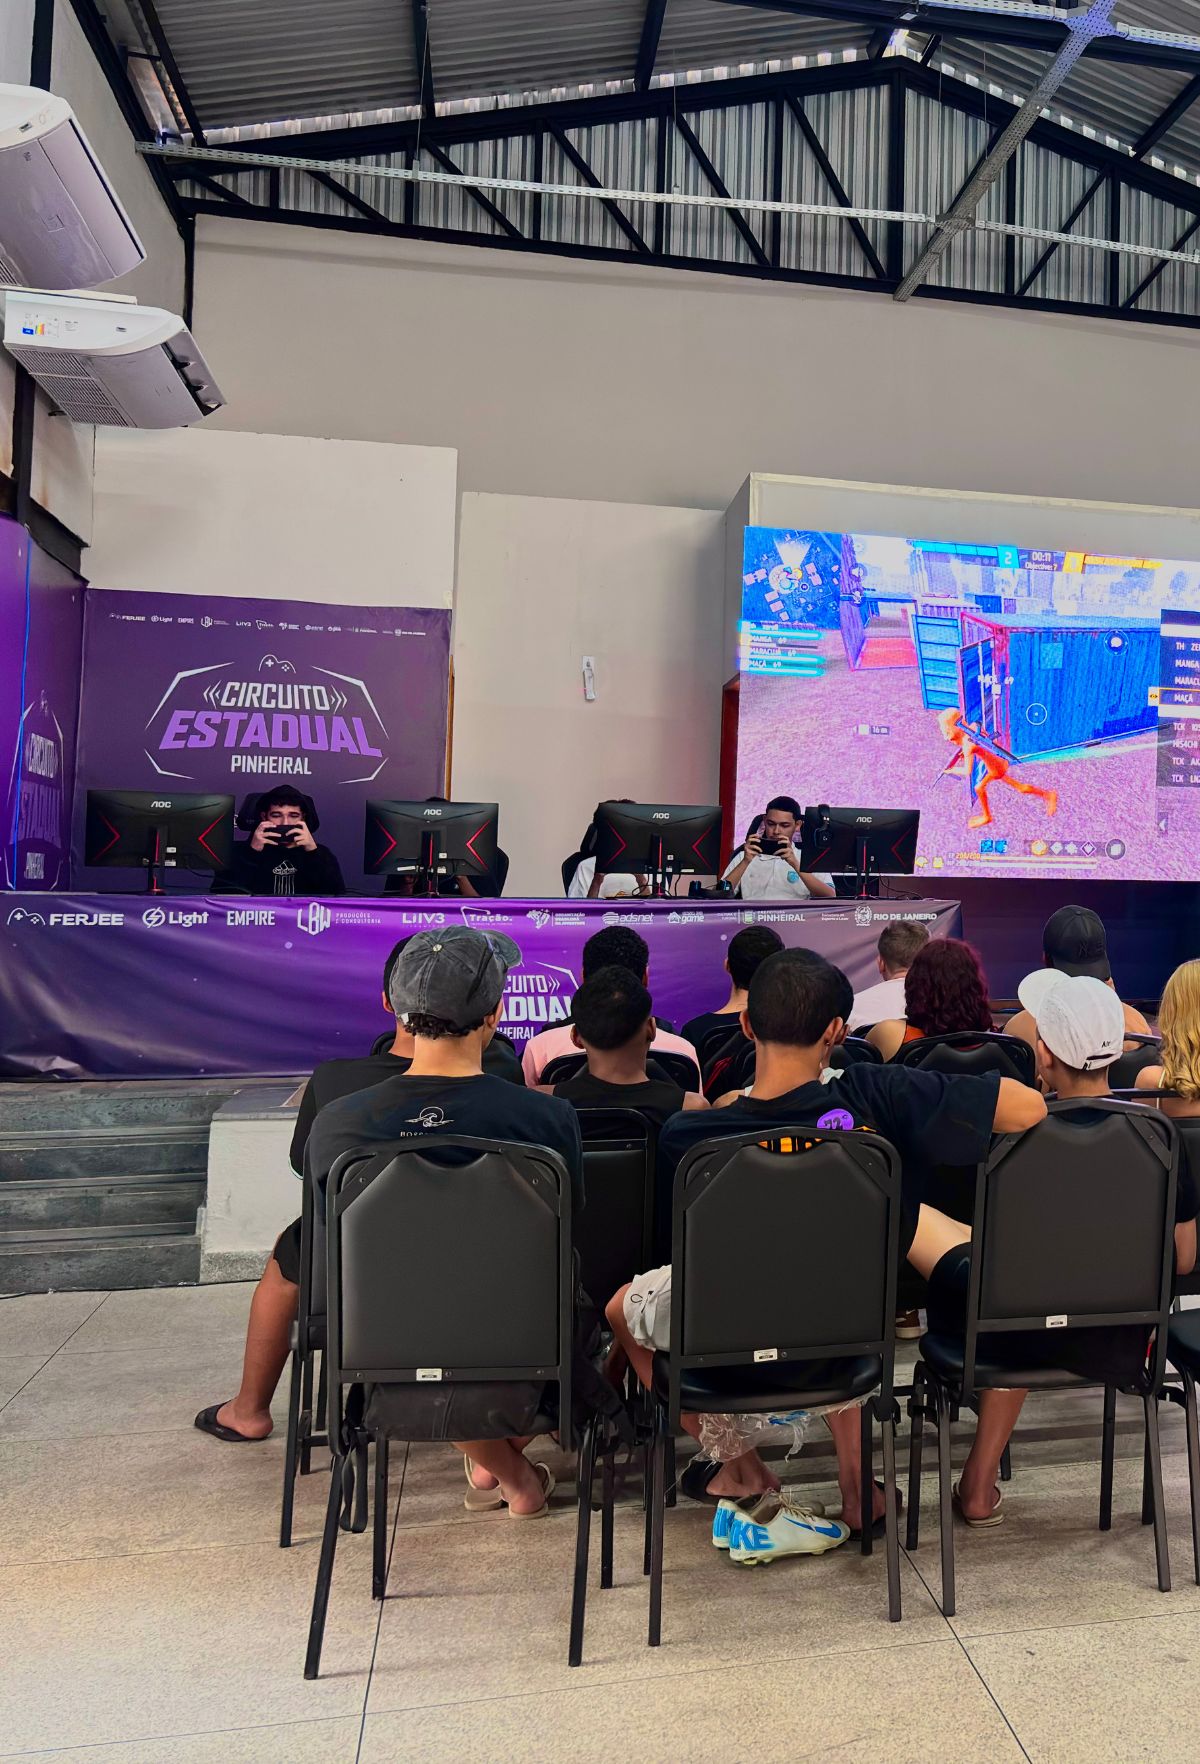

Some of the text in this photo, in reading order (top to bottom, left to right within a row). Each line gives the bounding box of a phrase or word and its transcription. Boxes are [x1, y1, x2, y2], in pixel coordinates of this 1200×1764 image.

[1175, 642, 1185, 651] TH
[1175, 660, 1200, 669] MANGA
[220, 682, 331, 711] CIRCUITO
[159, 709, 383, 758] ESTADUAL
[231, 755, 312, 775] PINHEIRAL
[150, 801, 171, 809] AOC
[652, 812, 670, 820] AOC
[49, 914, 125, 926] FERJEE
[169, 911, 209, 928] Light
[227, 911, 276, 926] EMPIRE
[297, 902, 332, 935] LBW
[469, 914, 513, 923] Tração.
[619, 912, 655, 922] adsnet
[681, 915, 705, 924] game
[758, 914, 806, 922] PINHEIRAL
[873, 913, 938, 921] RIO DE JANEIRO
[503, 975, 549, 993] CUITO
